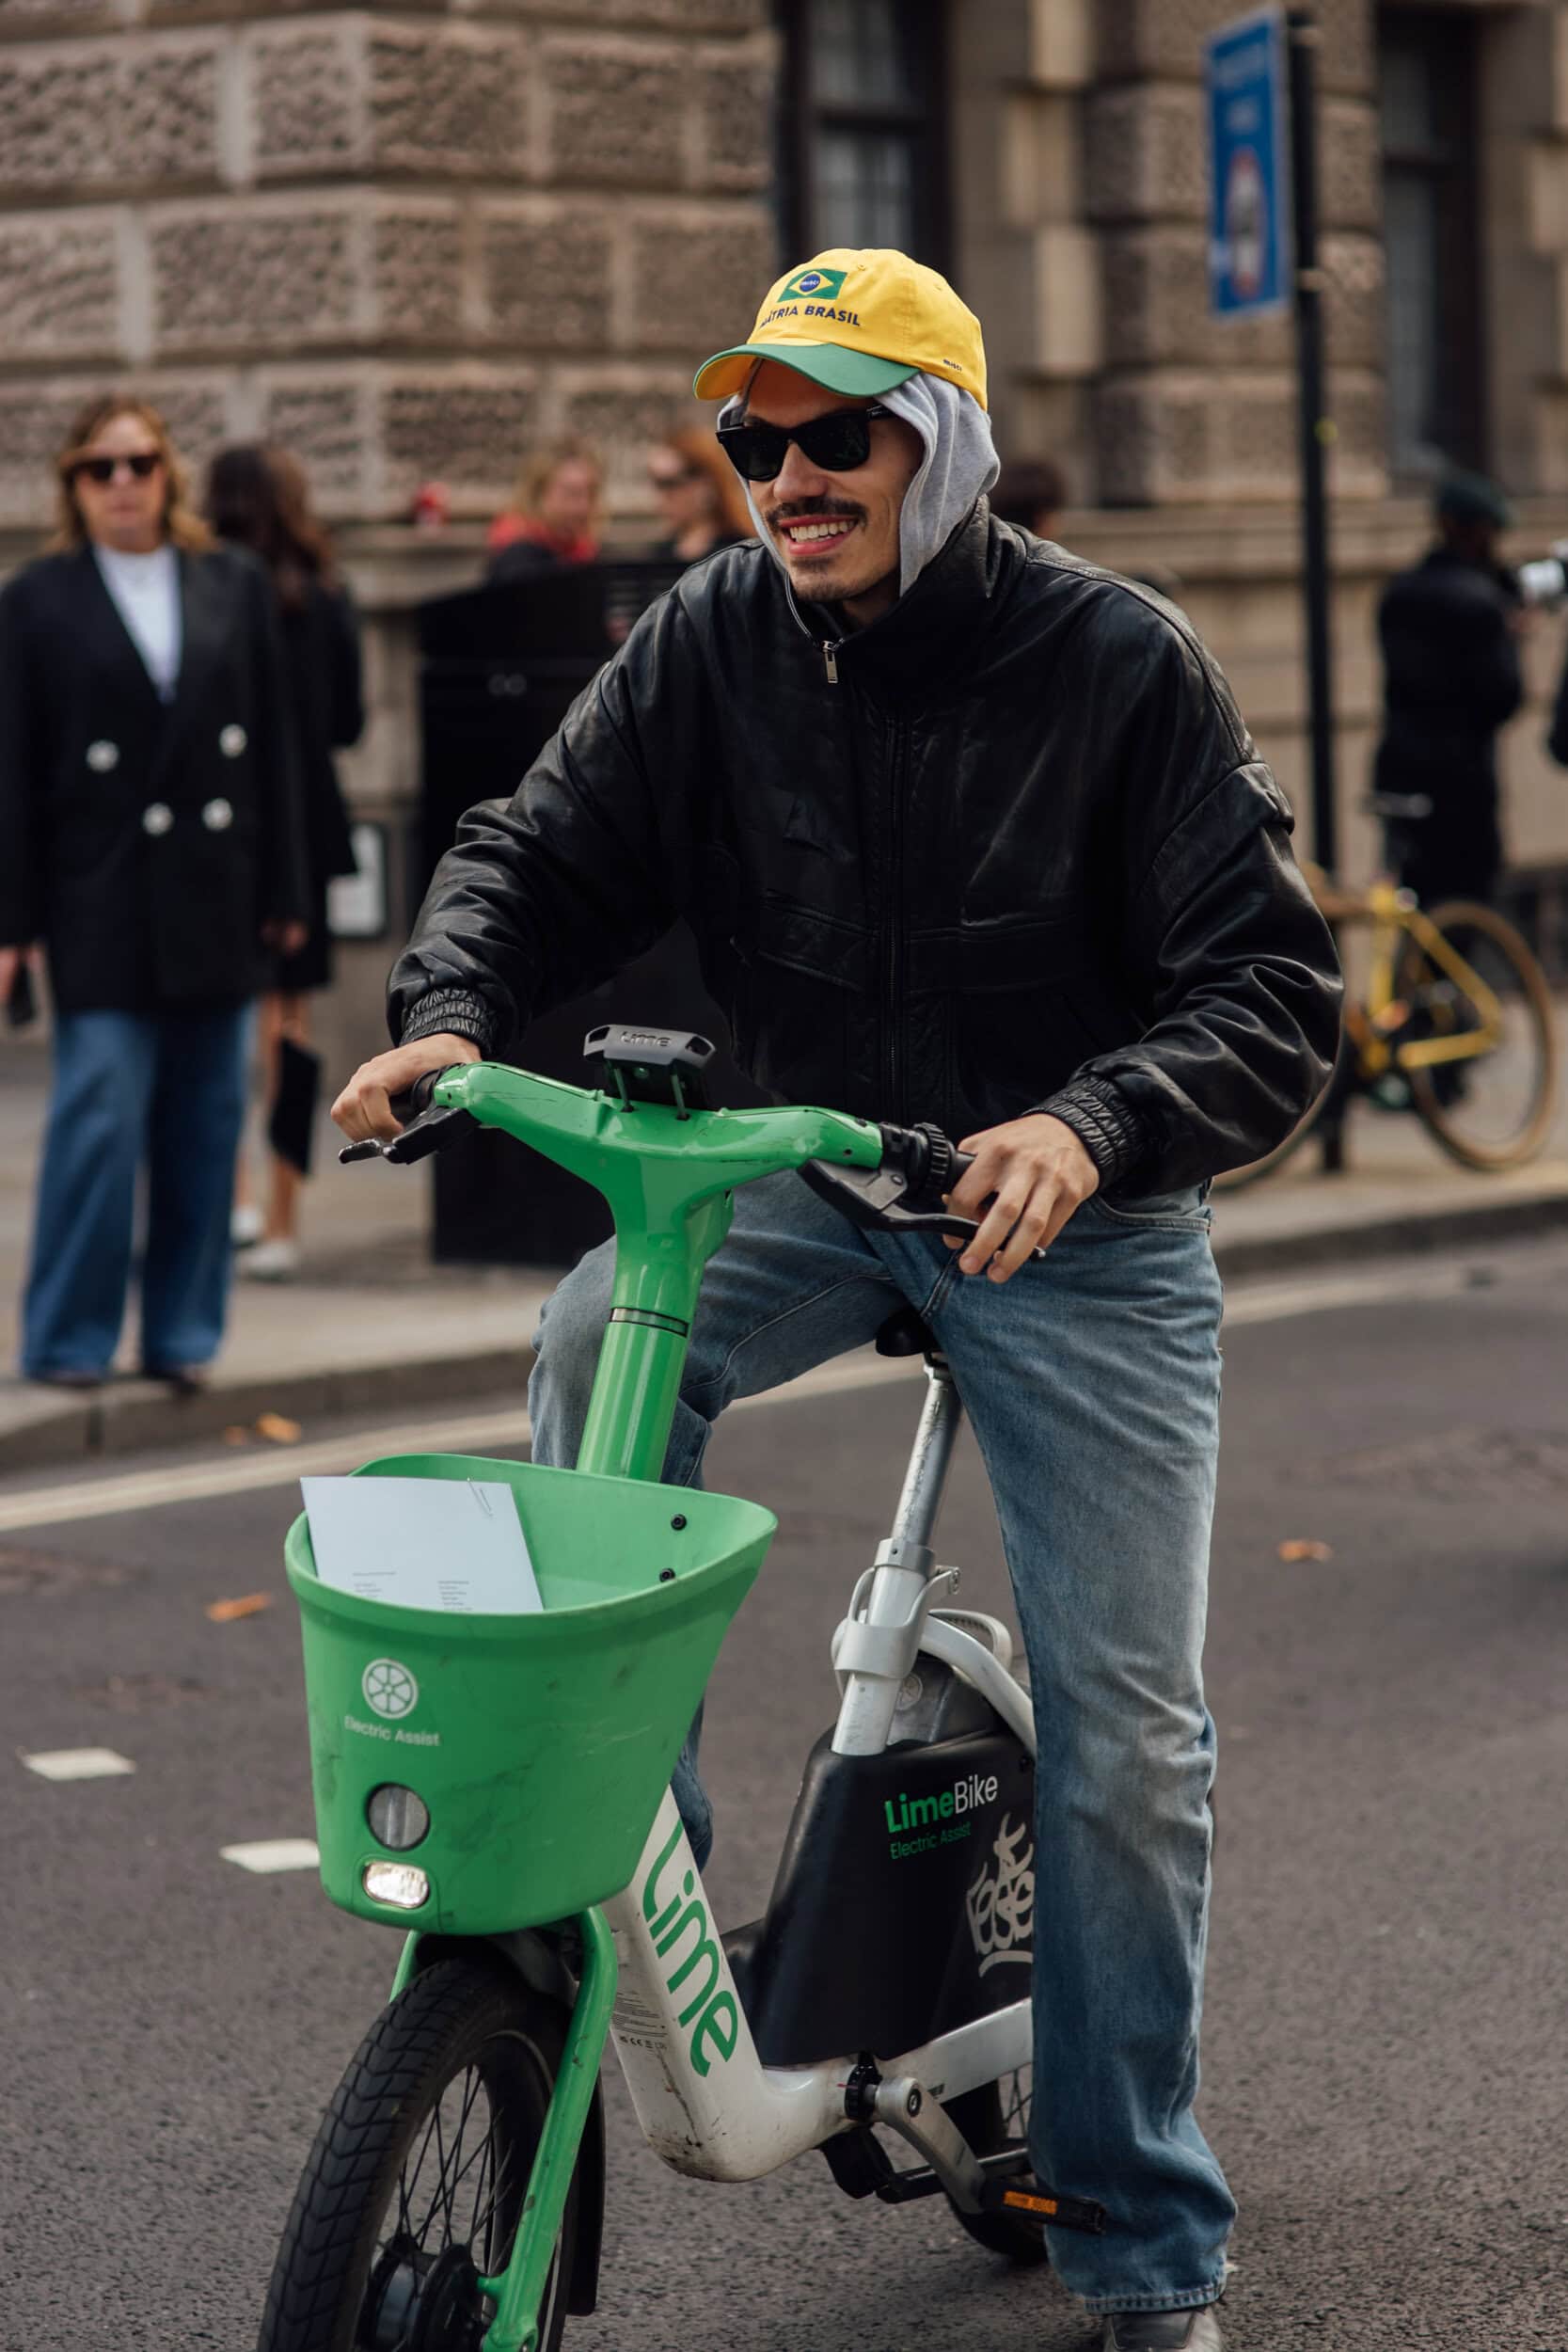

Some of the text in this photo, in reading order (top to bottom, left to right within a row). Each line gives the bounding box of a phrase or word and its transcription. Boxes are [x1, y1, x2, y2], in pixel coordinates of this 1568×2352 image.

[804, 306, 861, 326] BRASIL
[343, 1714, 441, 1746] Electric Assist
[884, 1773, 999, 1834] LimeBike
[889, 1820, 972, 1860] Electric Assist
[642, 1817, 738, 2078] Lime
